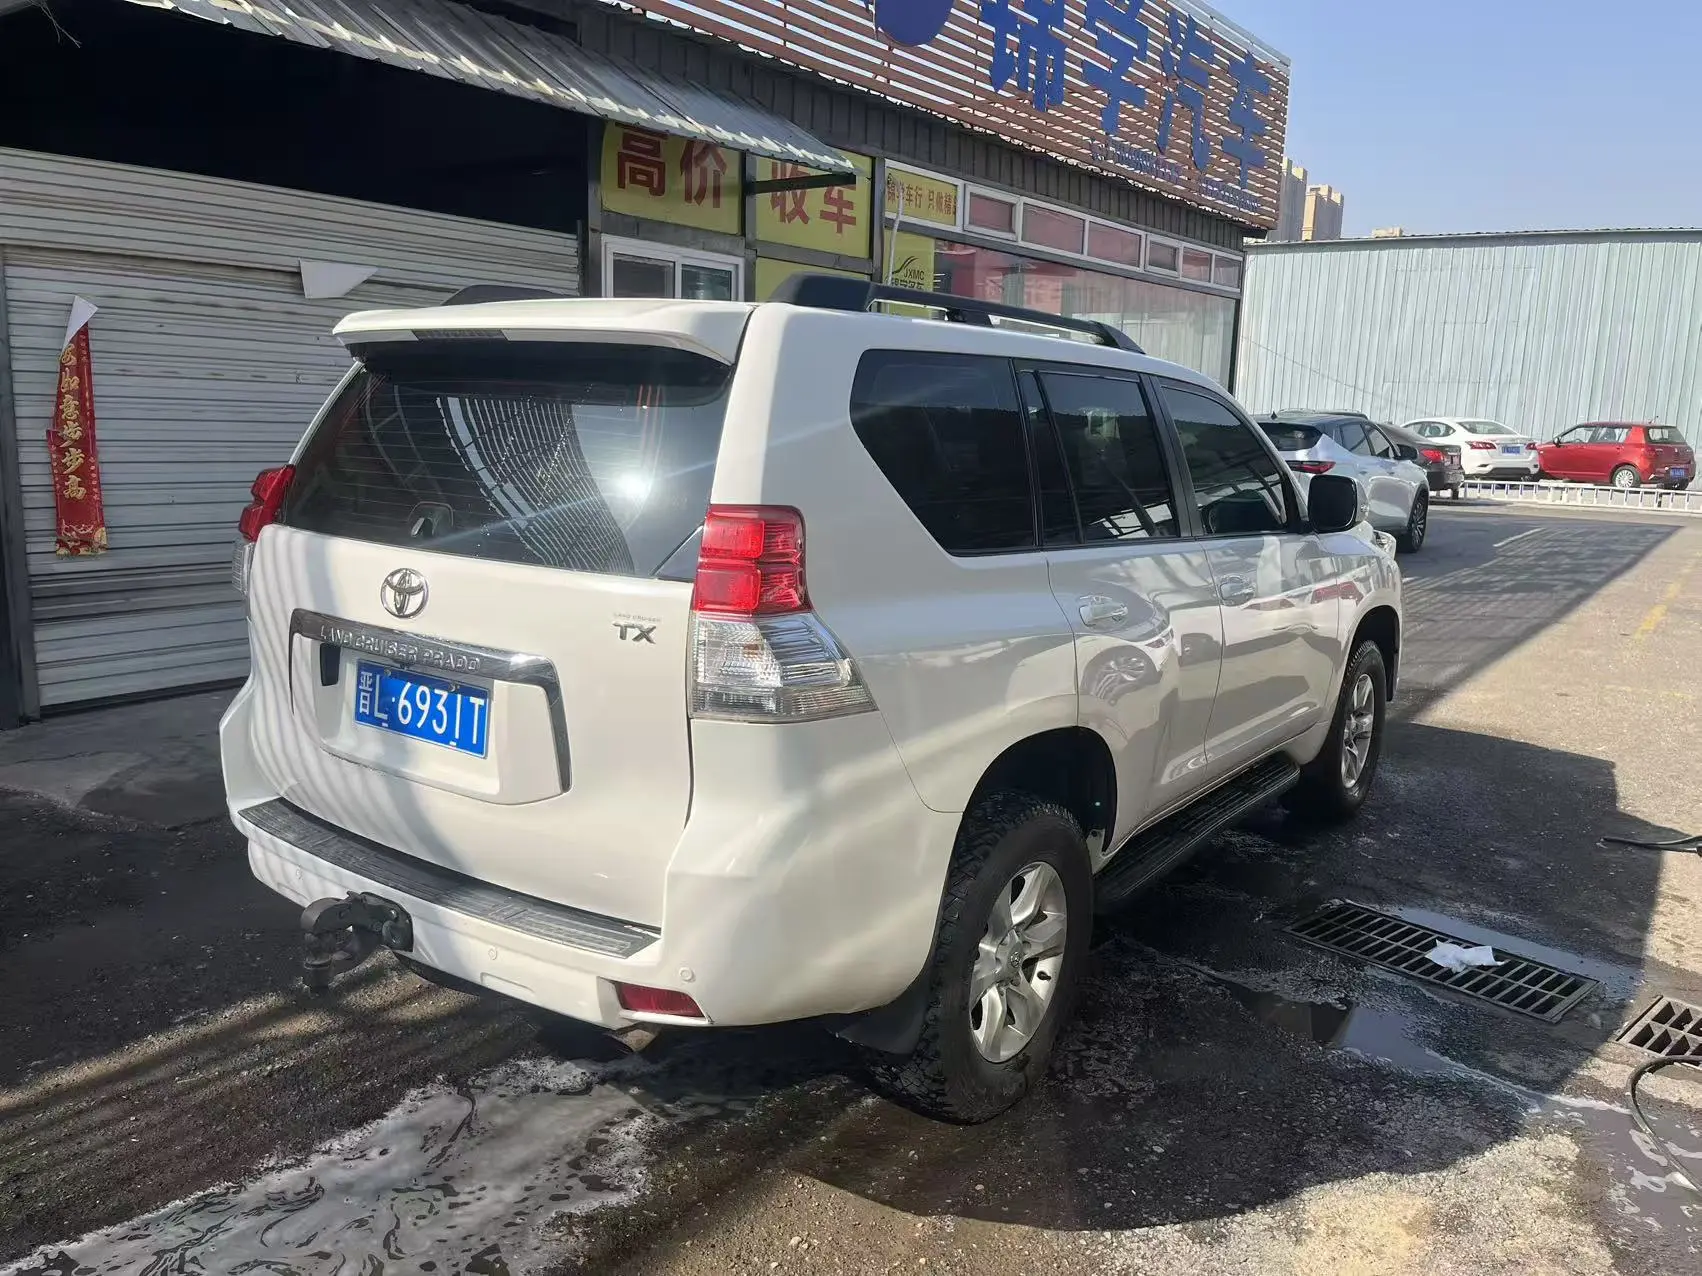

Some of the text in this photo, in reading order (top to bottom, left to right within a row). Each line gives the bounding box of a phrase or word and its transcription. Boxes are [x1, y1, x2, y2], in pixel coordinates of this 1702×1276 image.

[614, 121, 857, 234] 高价 收车
[903, 268, 925, 281] JXMC
[320, 624, 481, 673] LAND CRUISER PRADO
[612, 623, 657, 645] TX
